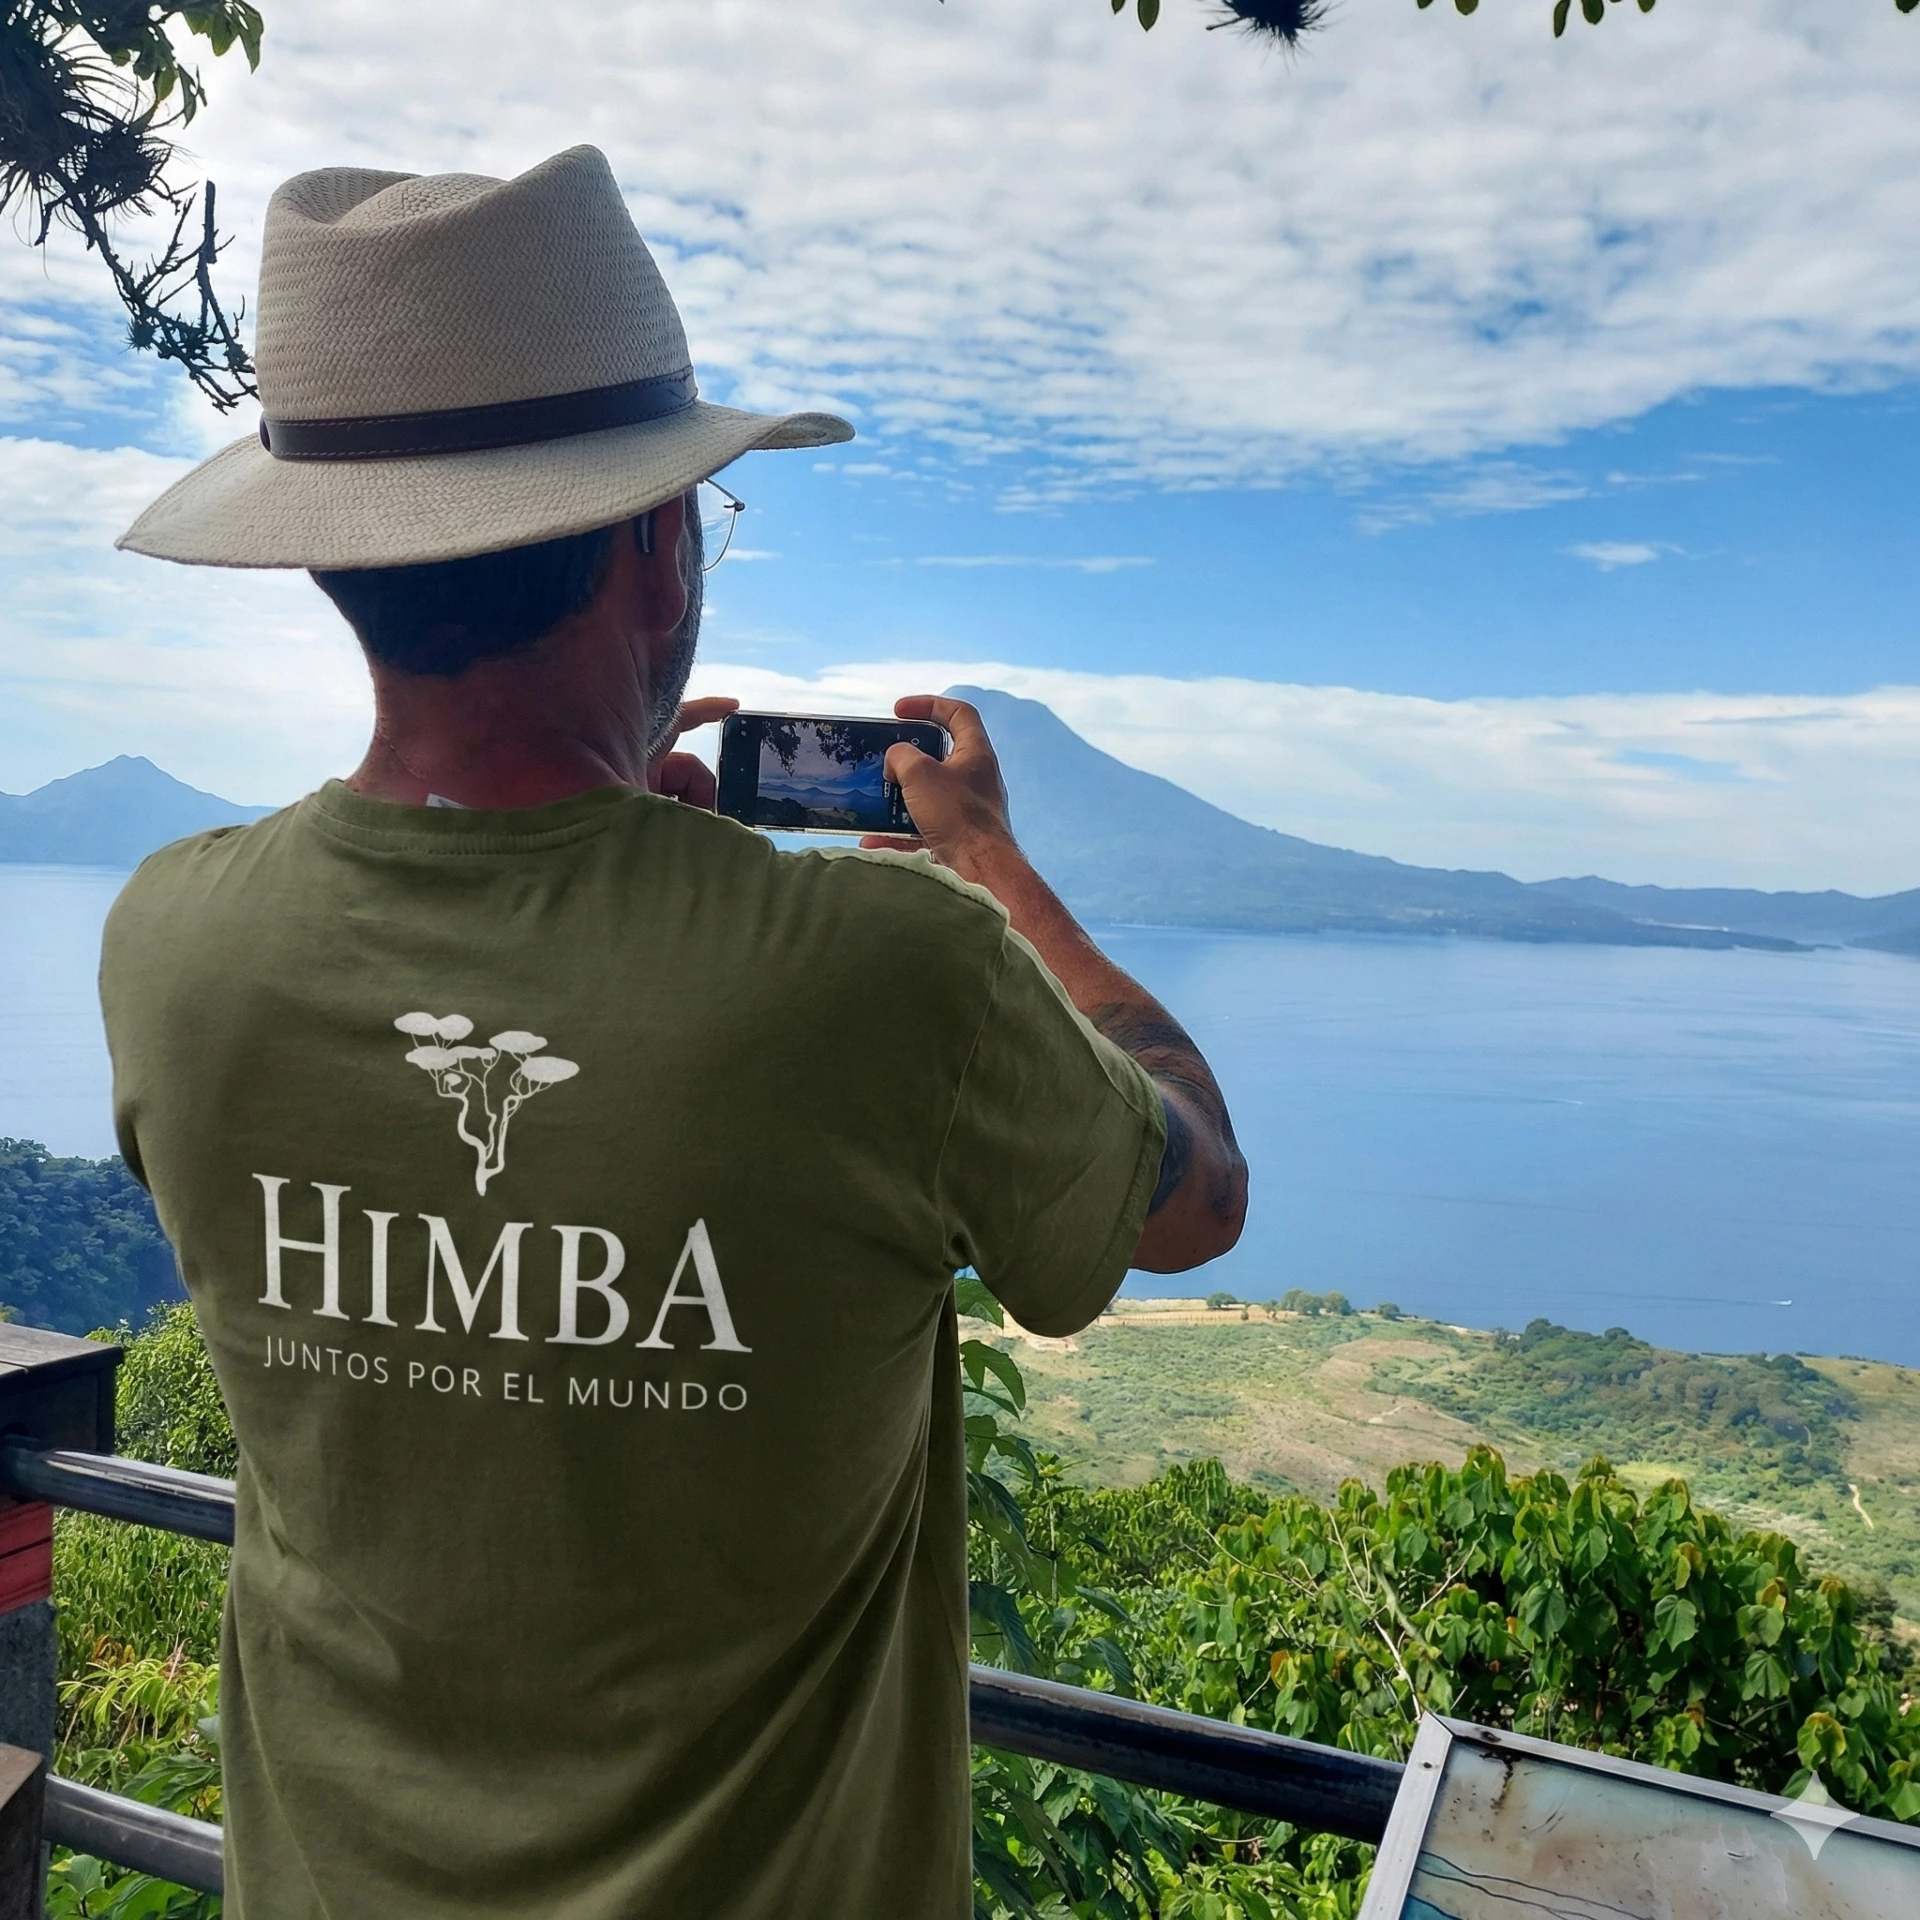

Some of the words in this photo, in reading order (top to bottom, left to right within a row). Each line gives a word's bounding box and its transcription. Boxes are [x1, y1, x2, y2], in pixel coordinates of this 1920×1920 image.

[251, 1172, 753, 1354] HIMBA
[263, 1335, 389, 1385] JUNTOS
[408, 1361, 482, 1397] POR
[503, 1372, 545, 1404] EL
[568, 1376, 748, 1412] MUNDO
